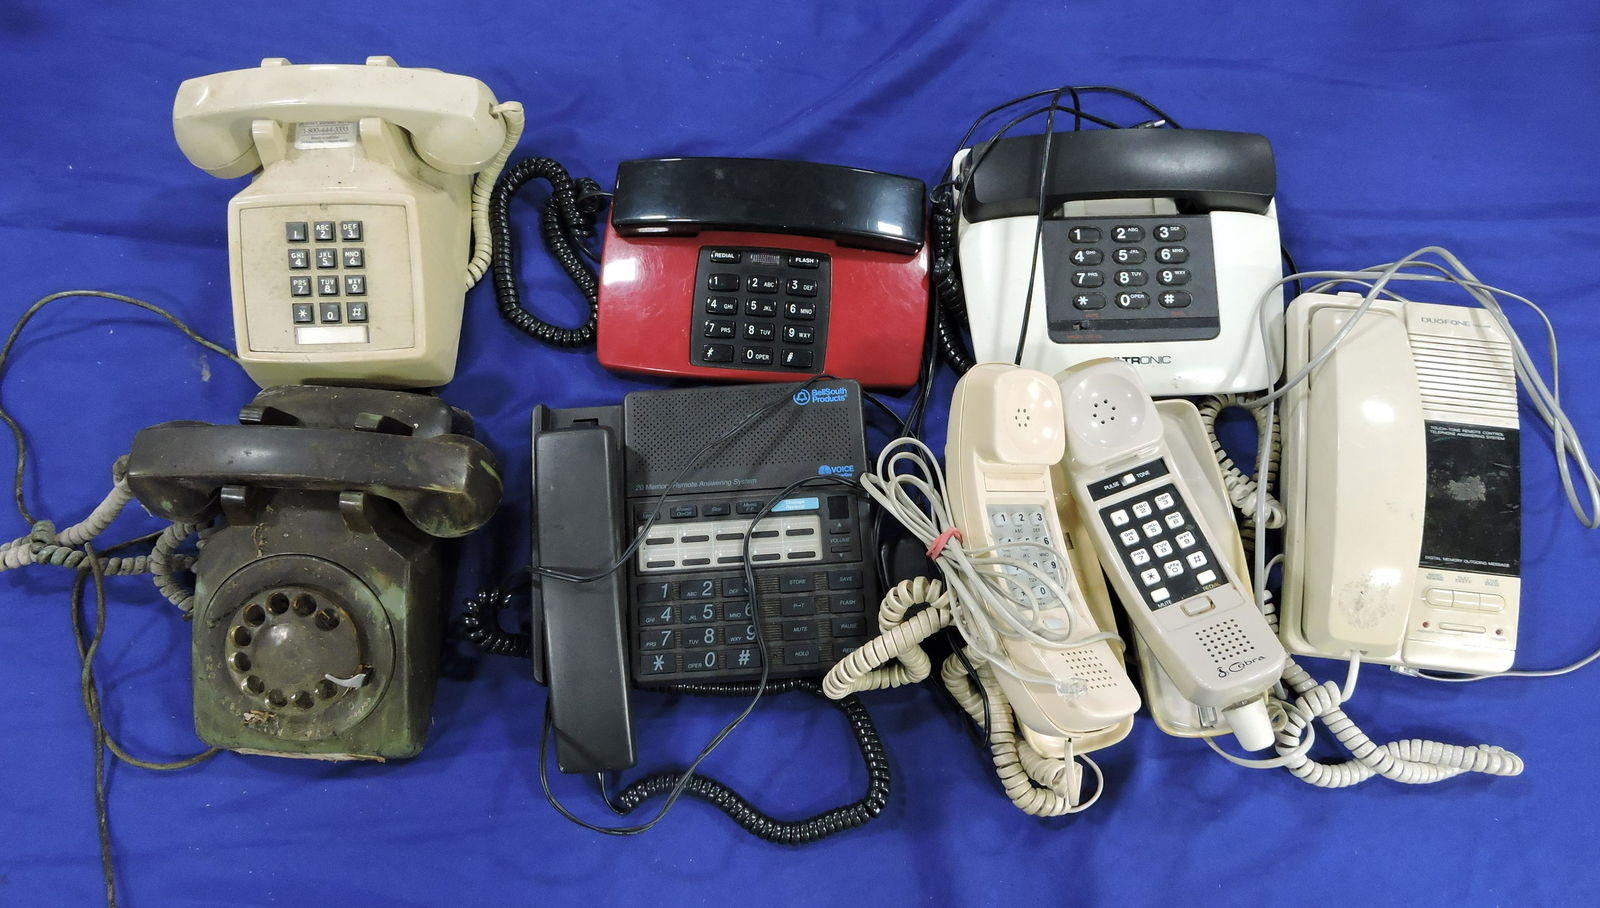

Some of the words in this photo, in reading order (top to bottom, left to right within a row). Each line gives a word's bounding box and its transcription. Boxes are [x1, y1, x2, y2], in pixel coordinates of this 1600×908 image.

[1074, 229, 1081, 240] 1
[1116, 228, 1126, 239] 2
[1159, 227, 1169, 238] 3
[1075, 251, 1084, 262] 4
[1118, 250, 1128, 261] 5
[1161, 249, 1171, 260] 6
[714, 277, 718, 285] 1
[1077, 273, 1086, 284] 7
[1119, 272, 1129, 283] 8
[1163, 270, 1173, 282] 9
[752, 278, 758, 287] 2
[792, 280, 798, 289] 3
[711, 299, 717, 308] 4
[1120, 294, 1131, 306] 0
[1164, 294, 1175, 304] #
[751, 301, 757, 310] 5
[790, 304, 796, 314] 6
[327, 312, 333, 320] 0
[352, 308, 361, 316] #
[1421, 317, 1470, 327] DUOFONE
[709, 323, 715, 332] 7
[748, 325, 755, 335] 8
[788, 328, 795, 337] 9
[747, 350, 753, 359] 0
[812, 387, 847, 395] BellSouth
[1136, 470, 1150, 478] TONE
[645, 483, 670, 491] Memor
[699, 479, 731, 488] Answering
[733, 478, 757, 486] System
[1104, 482, 1120, 490] PULSE
[1036, 513, 1042, 521] 3
[1044, 537, 1050, 545] 6
[1051, 561, 1056, 569] 9
[661, 584, 668, 598] 1
[702, 581, 712, 596] 2
[1040, 587, 1046, 595] 0
[1157, 600, 1172, 608] MUTE
[661, 606, 671, 622] 4
[703, 604, 713, 619] 5
[704, 628, 714, 643] 8
[746, 625, 756, 640] 9
[661, 630, 671, 646] 7
[704, 652, 715, 667] 0
[738, 649, 750, 665] #
[1229, 656, 1266, 672] Cobra
